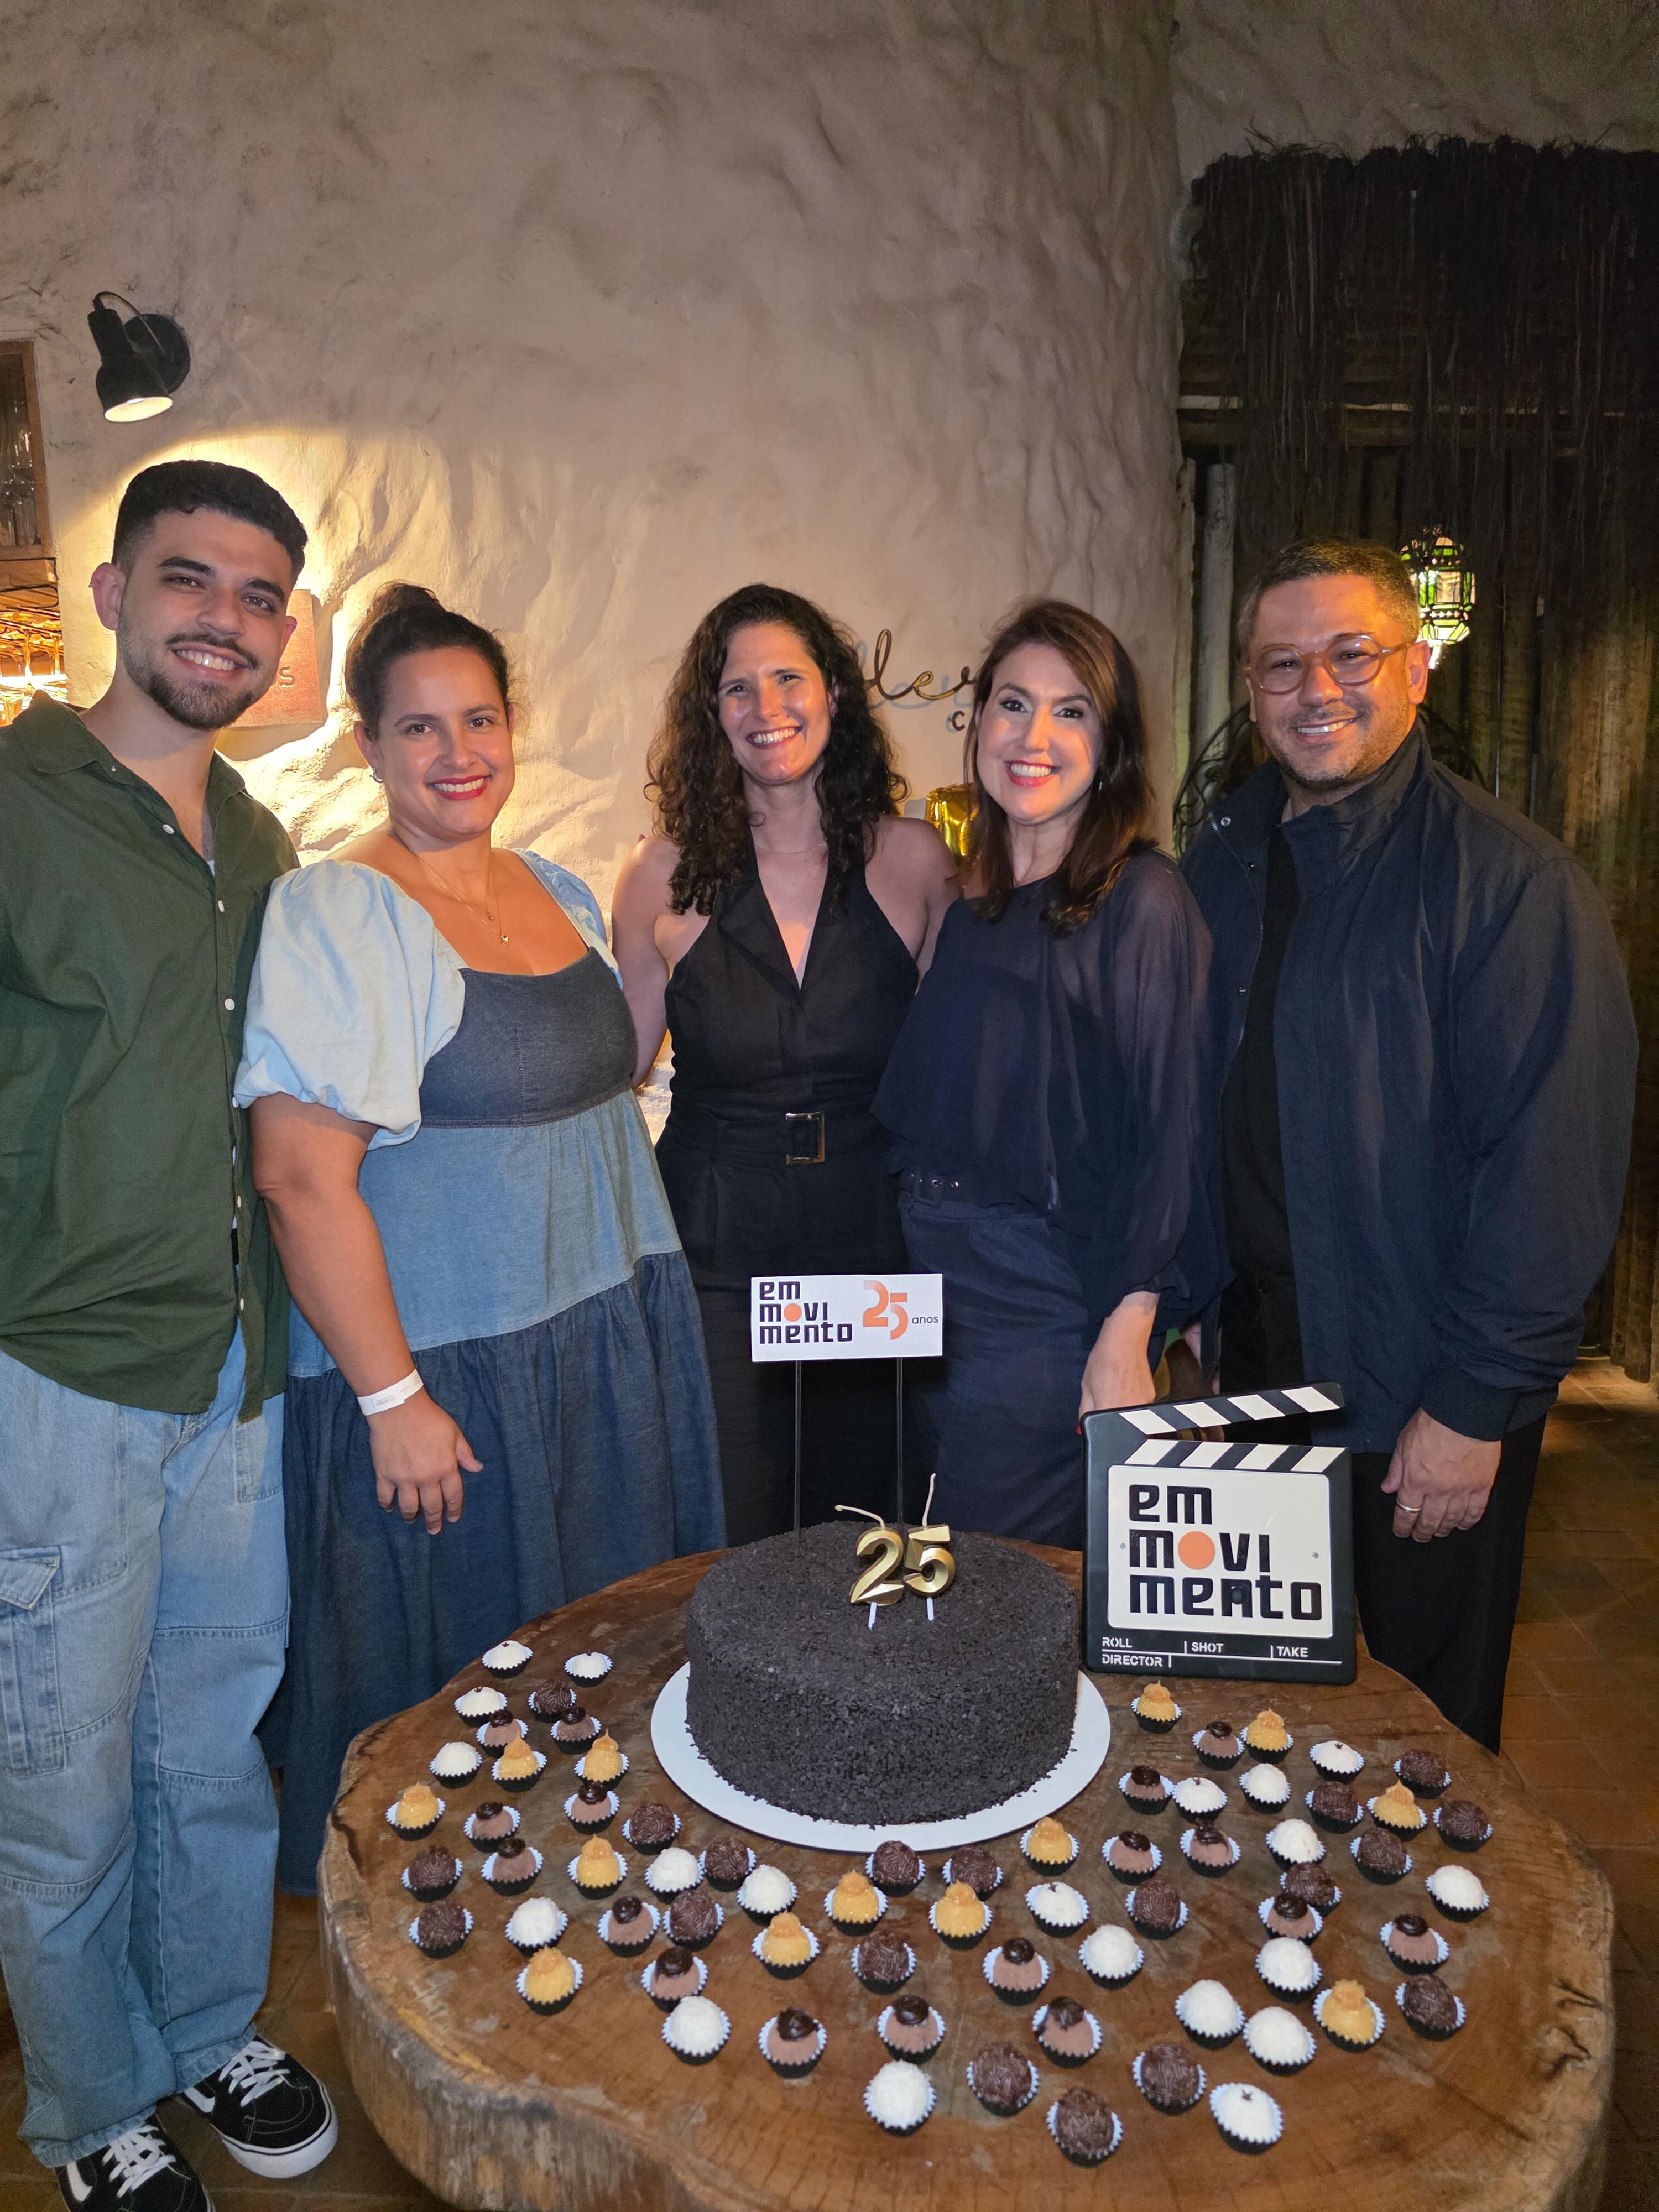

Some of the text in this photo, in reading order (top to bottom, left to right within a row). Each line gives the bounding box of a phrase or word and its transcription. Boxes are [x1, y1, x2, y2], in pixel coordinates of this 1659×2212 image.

[759, 1281, 800, 1300] em
[862, 1280, 909, 1340] 25
[912, 1314, 939, 1325] anos
[759, 1322, 853, 1344] mento
[1129, 1484, 1212, 1525] em
[849, 1524, 956, 1606] 25
[1129, 1574, 1323, 1621] mento
[1102, 1637, 1133, 1648] ROLL
[1191, 1641, 1224, 1653] SHOT
[1277, 1646, 1309, 1658] TAKE
[1102, 1653, 1163, 1667] DIRECTOR
